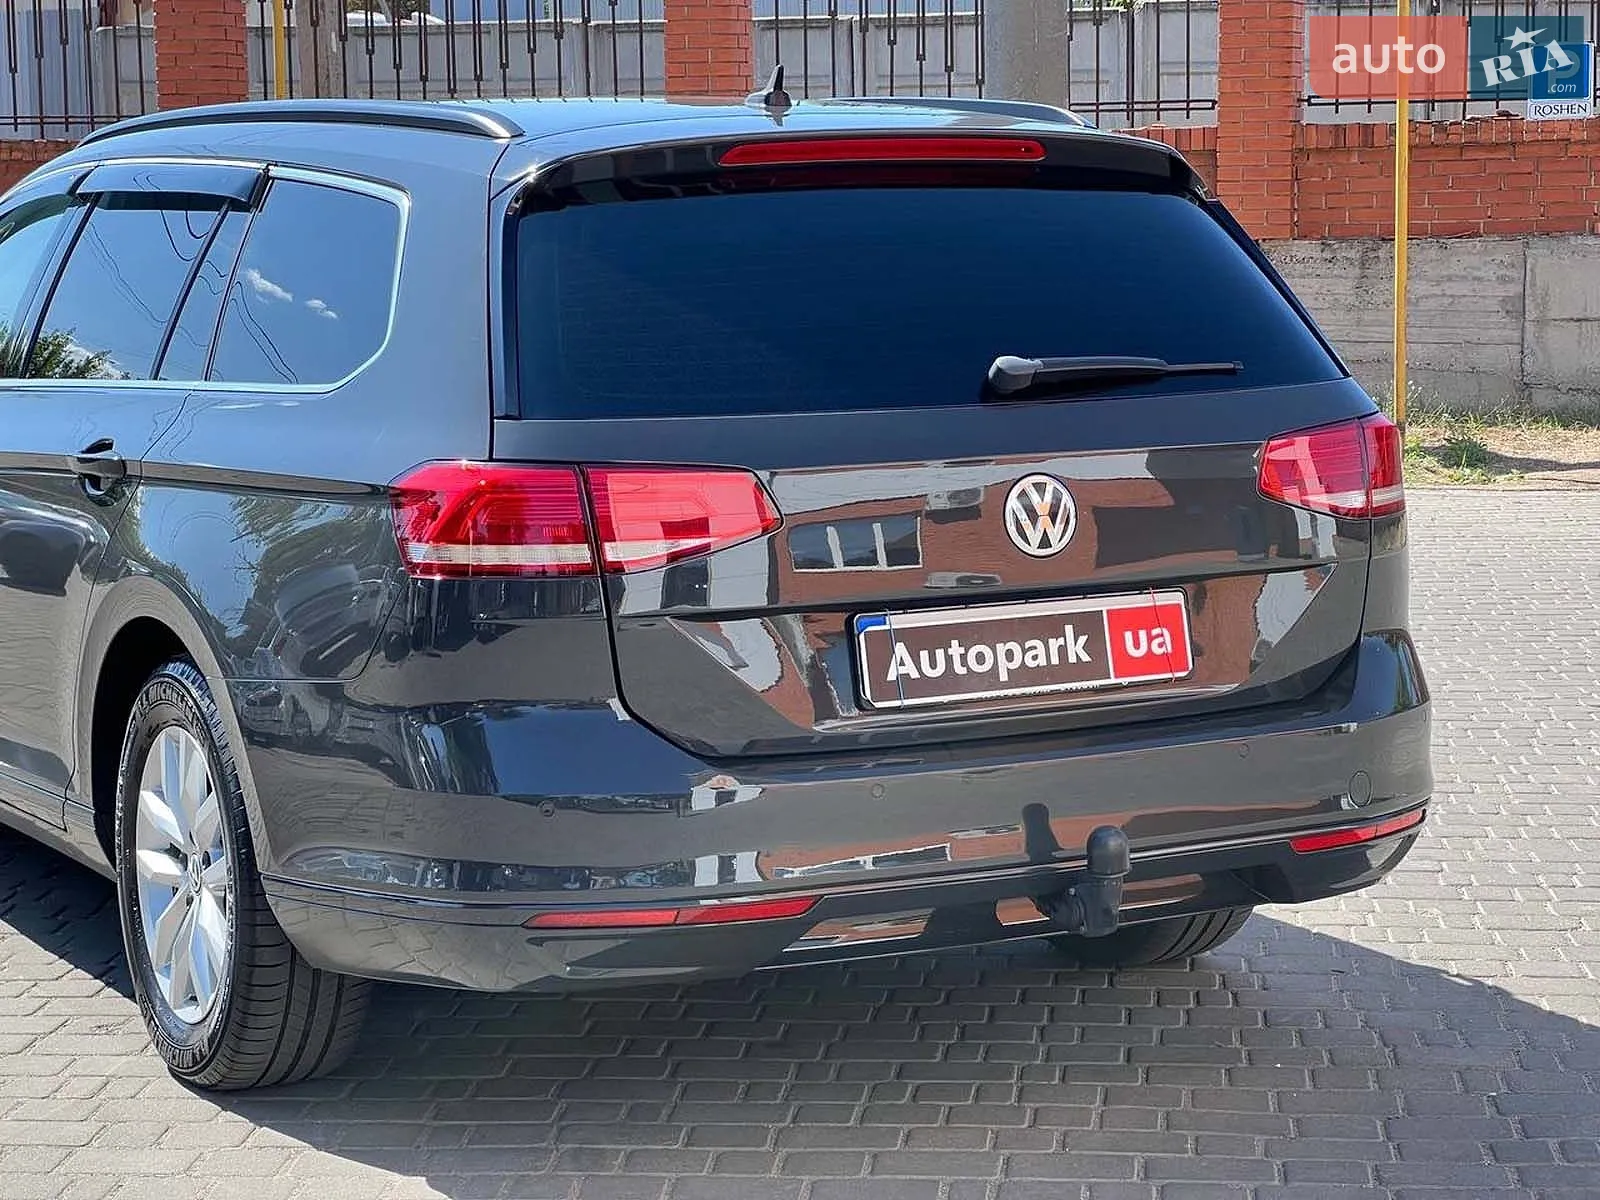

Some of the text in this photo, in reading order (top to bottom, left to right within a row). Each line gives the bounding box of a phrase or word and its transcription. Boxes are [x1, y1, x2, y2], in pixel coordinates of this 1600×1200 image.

[1534, 103, 1587, 117] ROSHEN
[887, 625, 1172, 682] Autopark ua
